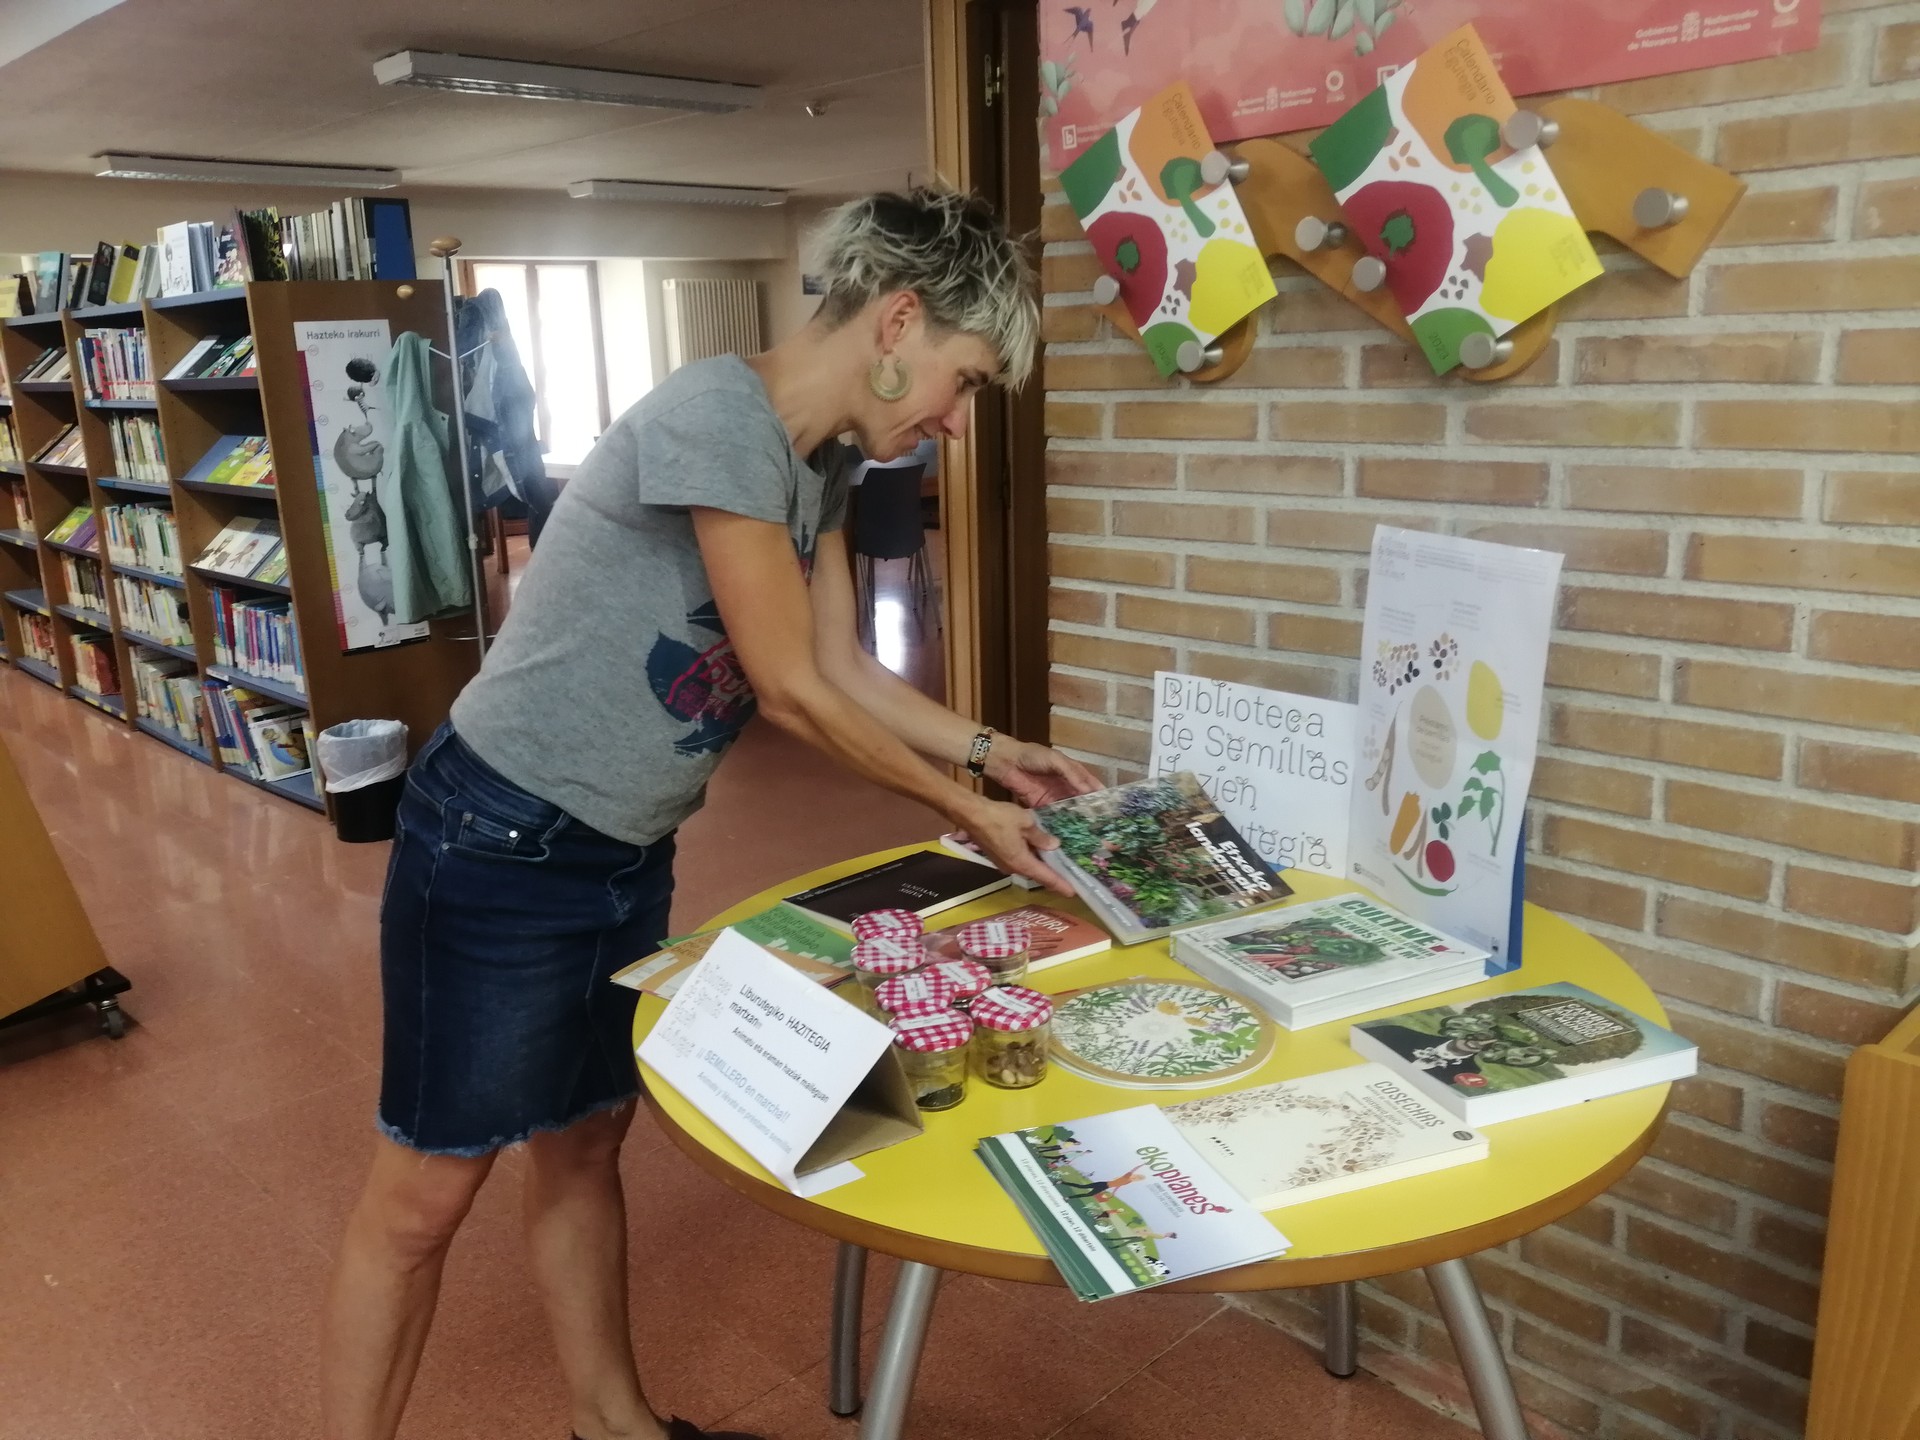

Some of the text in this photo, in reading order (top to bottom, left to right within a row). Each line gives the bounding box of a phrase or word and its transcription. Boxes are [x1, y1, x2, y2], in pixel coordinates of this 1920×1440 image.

[1457, 39, 1495, 104] Calendario
[306, 328, 380, 340] Hazteko irakurri
[1162, 677, 1324, 738] Biblioteca
[1159, 713, 1348, 785] de Semillas
[1157, 753, 1258, 811] Hzien
[1185, 821, 1260, 896] landareak
[1218, 840, 1272, 891] Etxeko
[1015, 909, 1069, 934] NATURA
[1339, 900, 1445, 946] CULTIVE
[739, 984, 831, 1054] Liburutegiko HAZITEGIA
[1565, 1003, 1625, 1031] CAMBIAR
[704, 1050, 748, 1088] SEMILLERO
[745, 1085, 756, 1098] en
[1374, 1080, 1445, 1128] COSECHAS
[1136, 1146, 1217, 1215] ekoplanes
